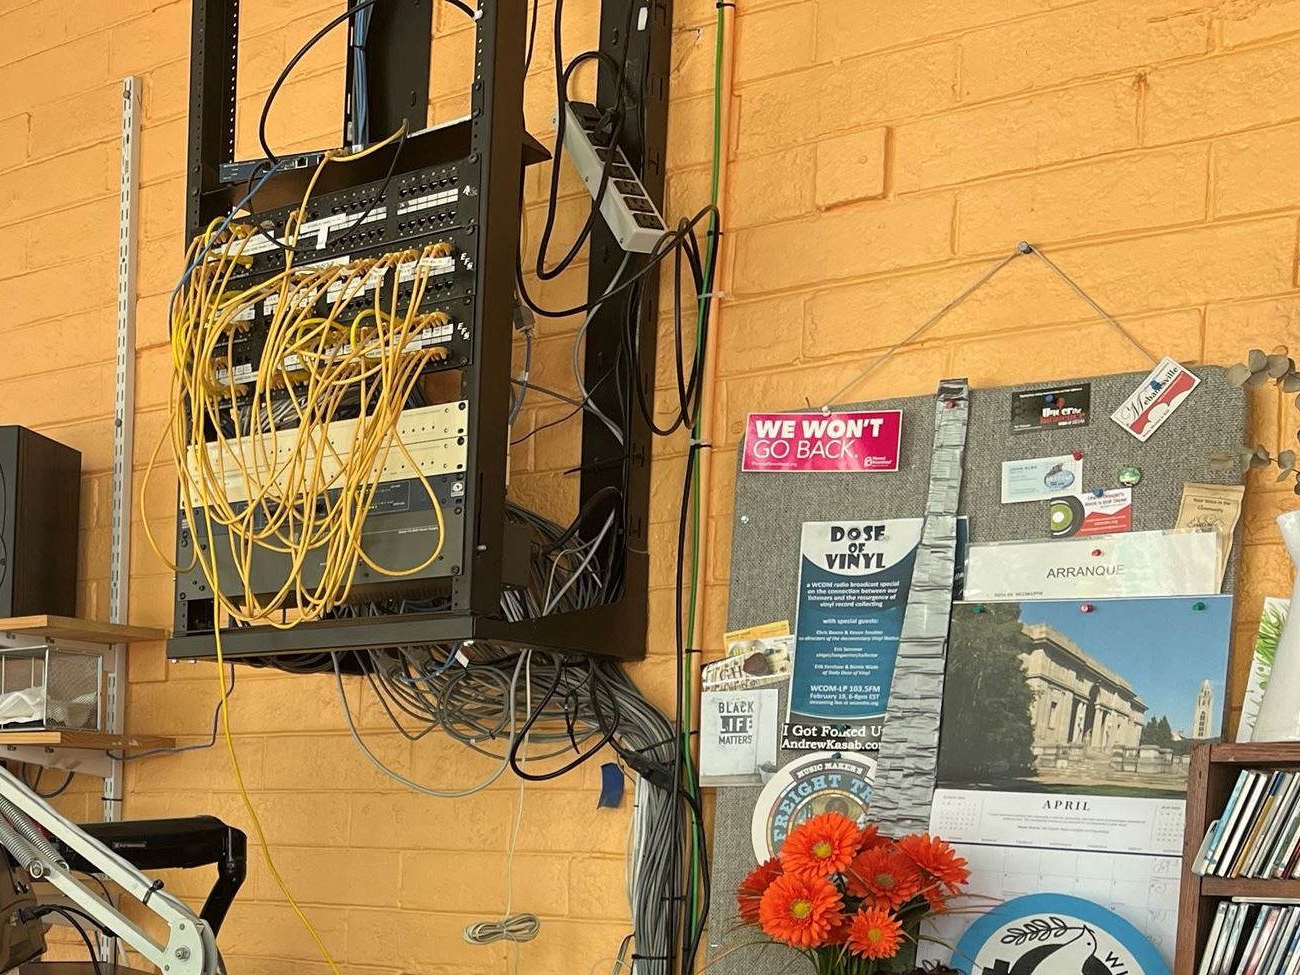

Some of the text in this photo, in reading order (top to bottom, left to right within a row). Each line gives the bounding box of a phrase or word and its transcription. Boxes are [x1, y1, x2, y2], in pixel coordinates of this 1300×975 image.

[755, 418, 884, 439] WE WON'T
[753, 439, 858, 459] GO BACK.
[831, 525, 886, 542] DOSE
[848, 543, 866, 553] OF
[826, 553, 886, 569] VINYL
[1046, 564, 1125, 578] ARRANQUE
[880, 580, 900, 588] special
[855, 600, 883, 608] collecting
[857, 594, 889, 602] resurgence
[849, 685, 881, 693] 103.5FM
[718, 702, 754, 713] BLACK
[783, 725, 788, 736] I
[792, 725, 818, 737] Got
[718, 735, 753, 745] MATTERS
[796, 763, 823, 778] MUSIC
[773, 774, 842, 841] FREIGHT
[1042, 799, 1091, 811] APRIL
